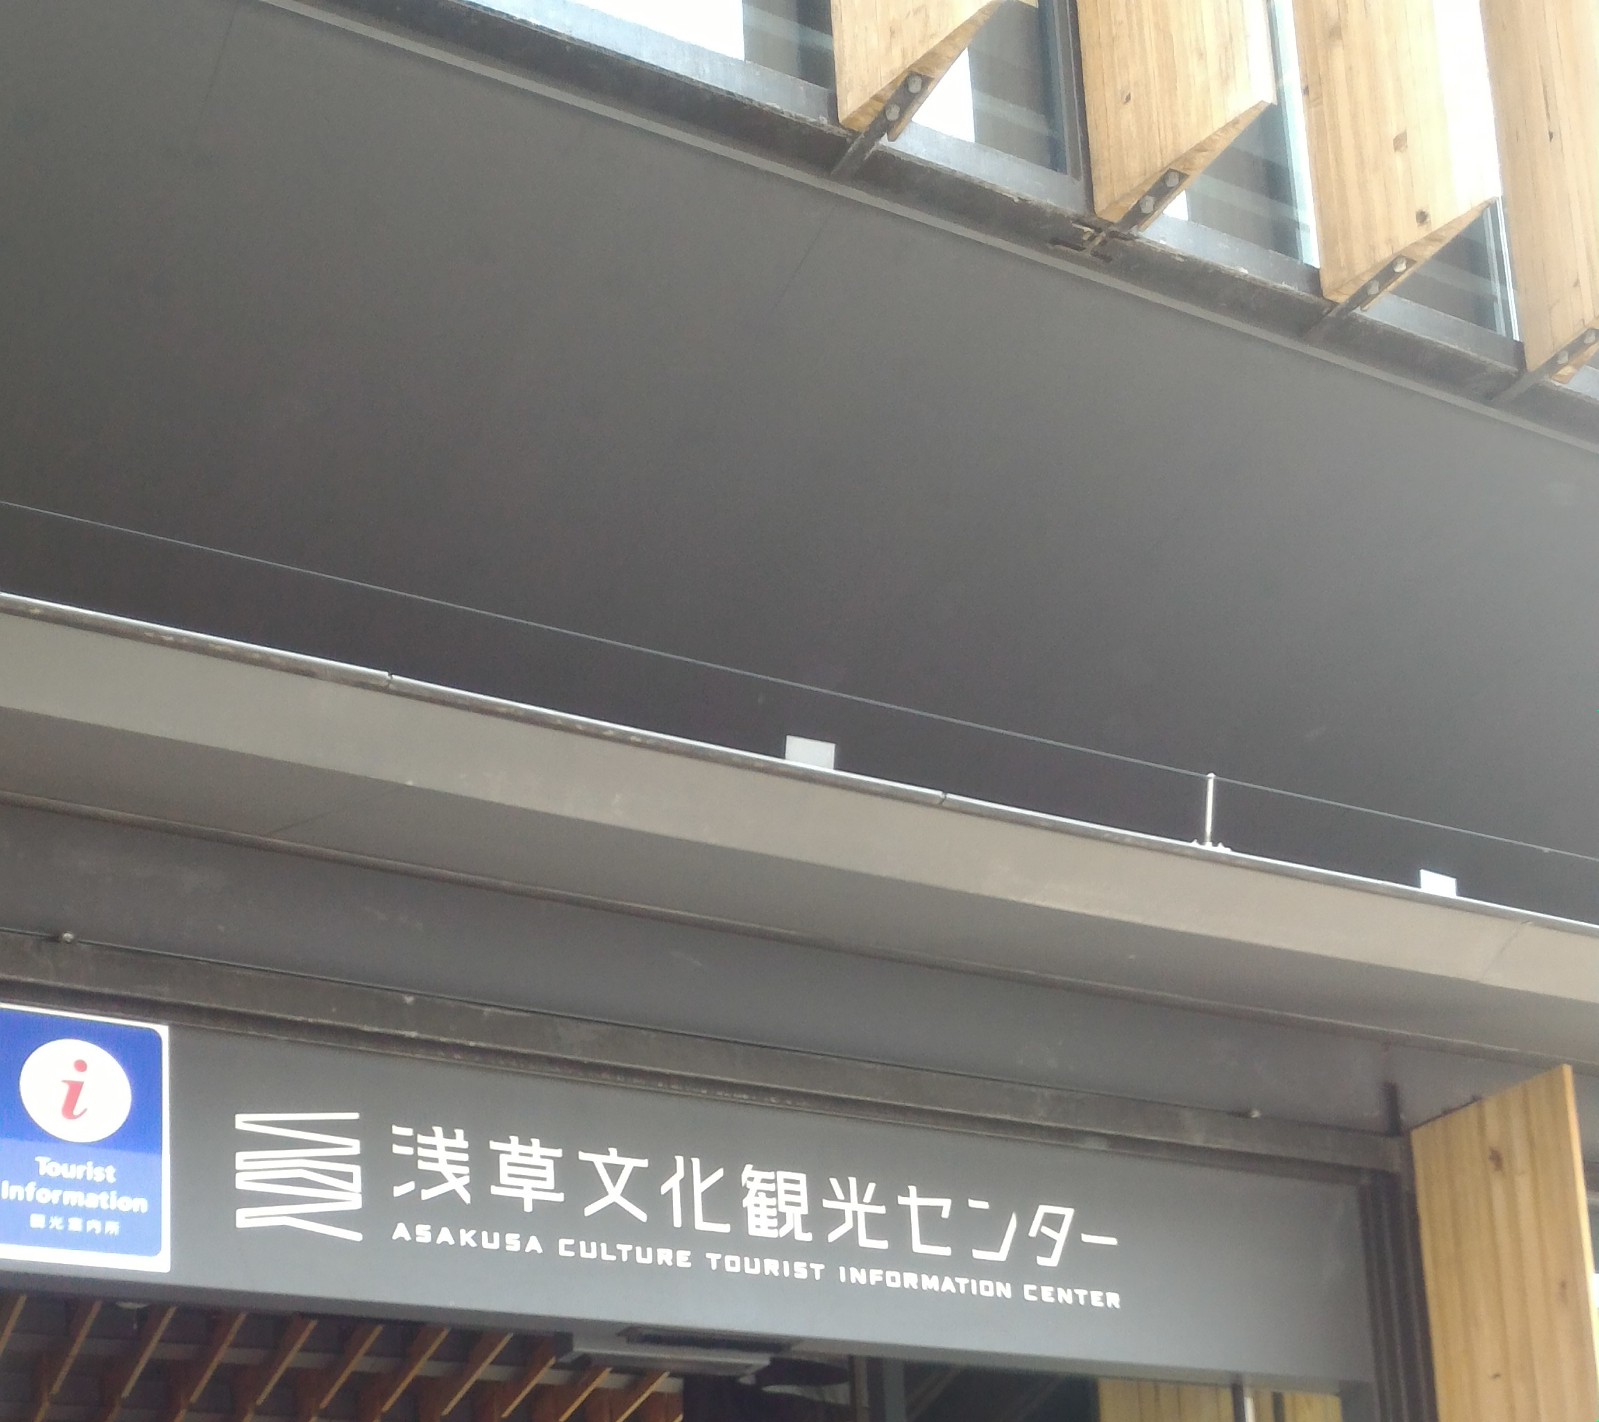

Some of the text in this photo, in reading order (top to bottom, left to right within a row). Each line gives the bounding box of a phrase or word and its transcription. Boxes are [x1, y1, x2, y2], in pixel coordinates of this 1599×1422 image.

[0, 1179, 149, 1214] Information
[34, 1156, 117, 1184] Tourist
[391, 1124, 1120, 1268] 浅草文化観光センター
[391, 1222, 1121, 1309] ASAKUSA CULTURE TOURIST INFORMATION CENTER
